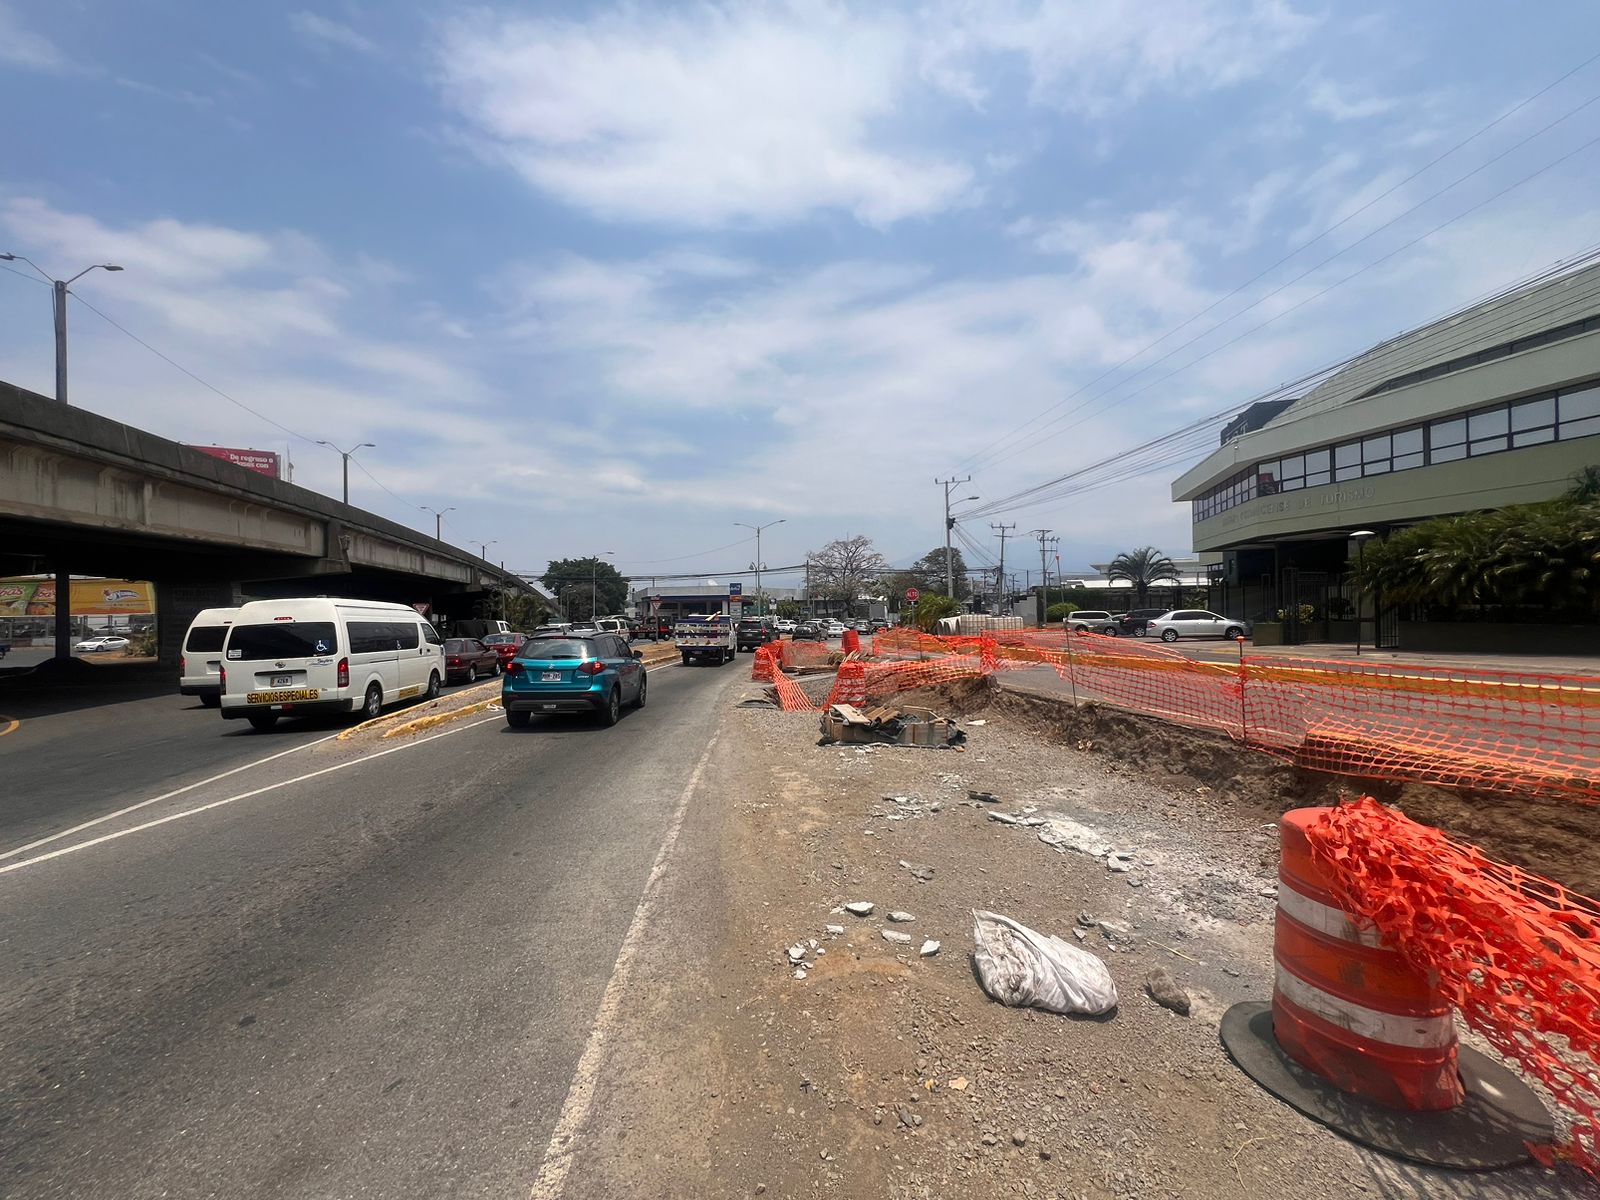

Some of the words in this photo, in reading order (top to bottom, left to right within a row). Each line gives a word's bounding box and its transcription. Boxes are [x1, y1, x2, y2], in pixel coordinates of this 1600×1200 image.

[241, 455, 268, 463] regreso
[1320, 487, 1376, 505] TURISMO
[246, 692, 279, 704] SERVICIOS
[279, 689, 319, 702] ESPECIALES
